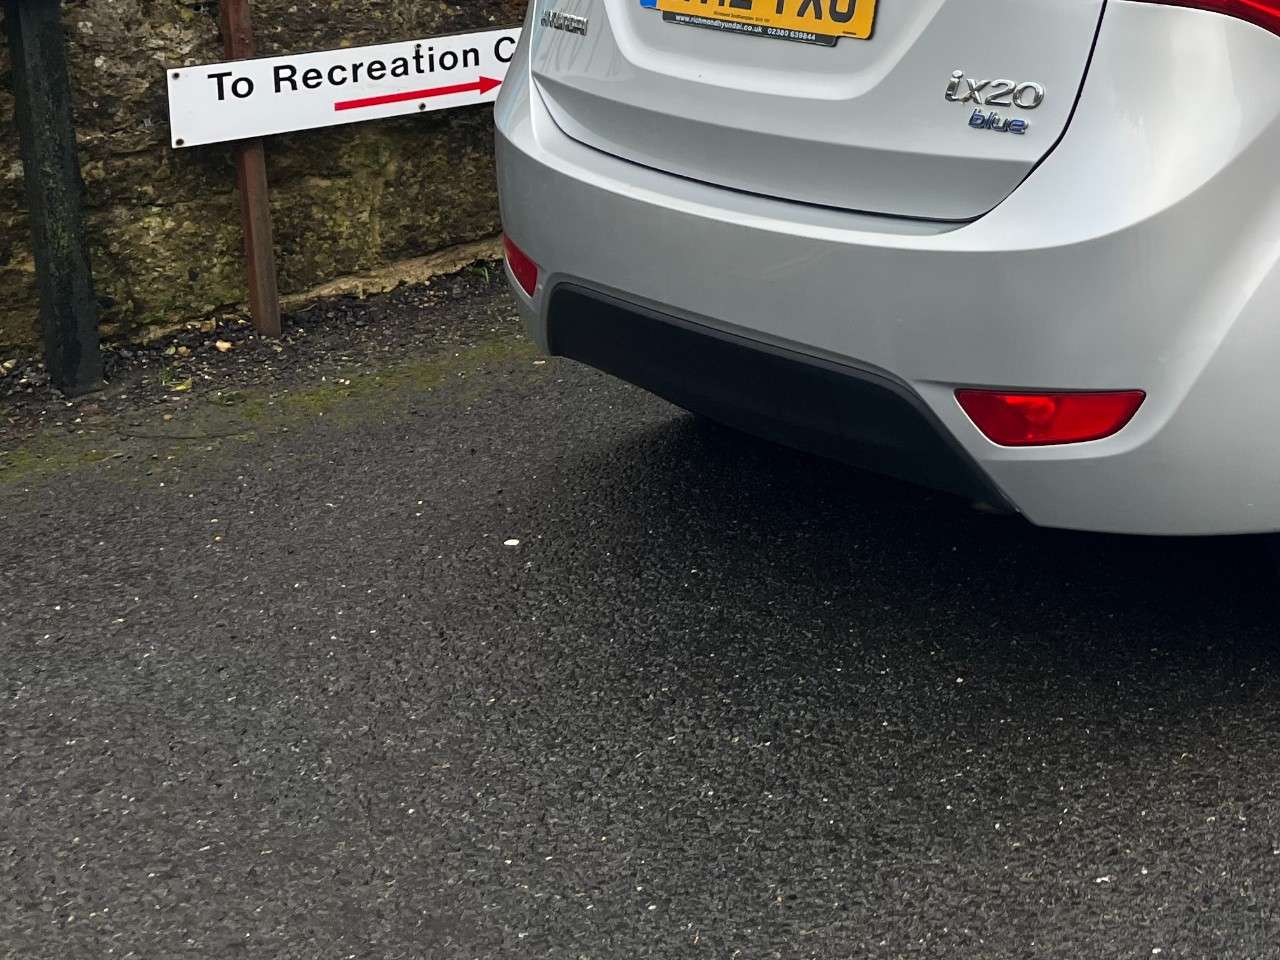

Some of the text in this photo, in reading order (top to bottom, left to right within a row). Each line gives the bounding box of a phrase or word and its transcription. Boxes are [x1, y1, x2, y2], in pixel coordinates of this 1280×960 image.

[207, 70, 255, 101] To
[272, 43, 481, 95] Recreation
[945, 69, 1044, 109] ix20
[968, 107, 1030, 135] blue
